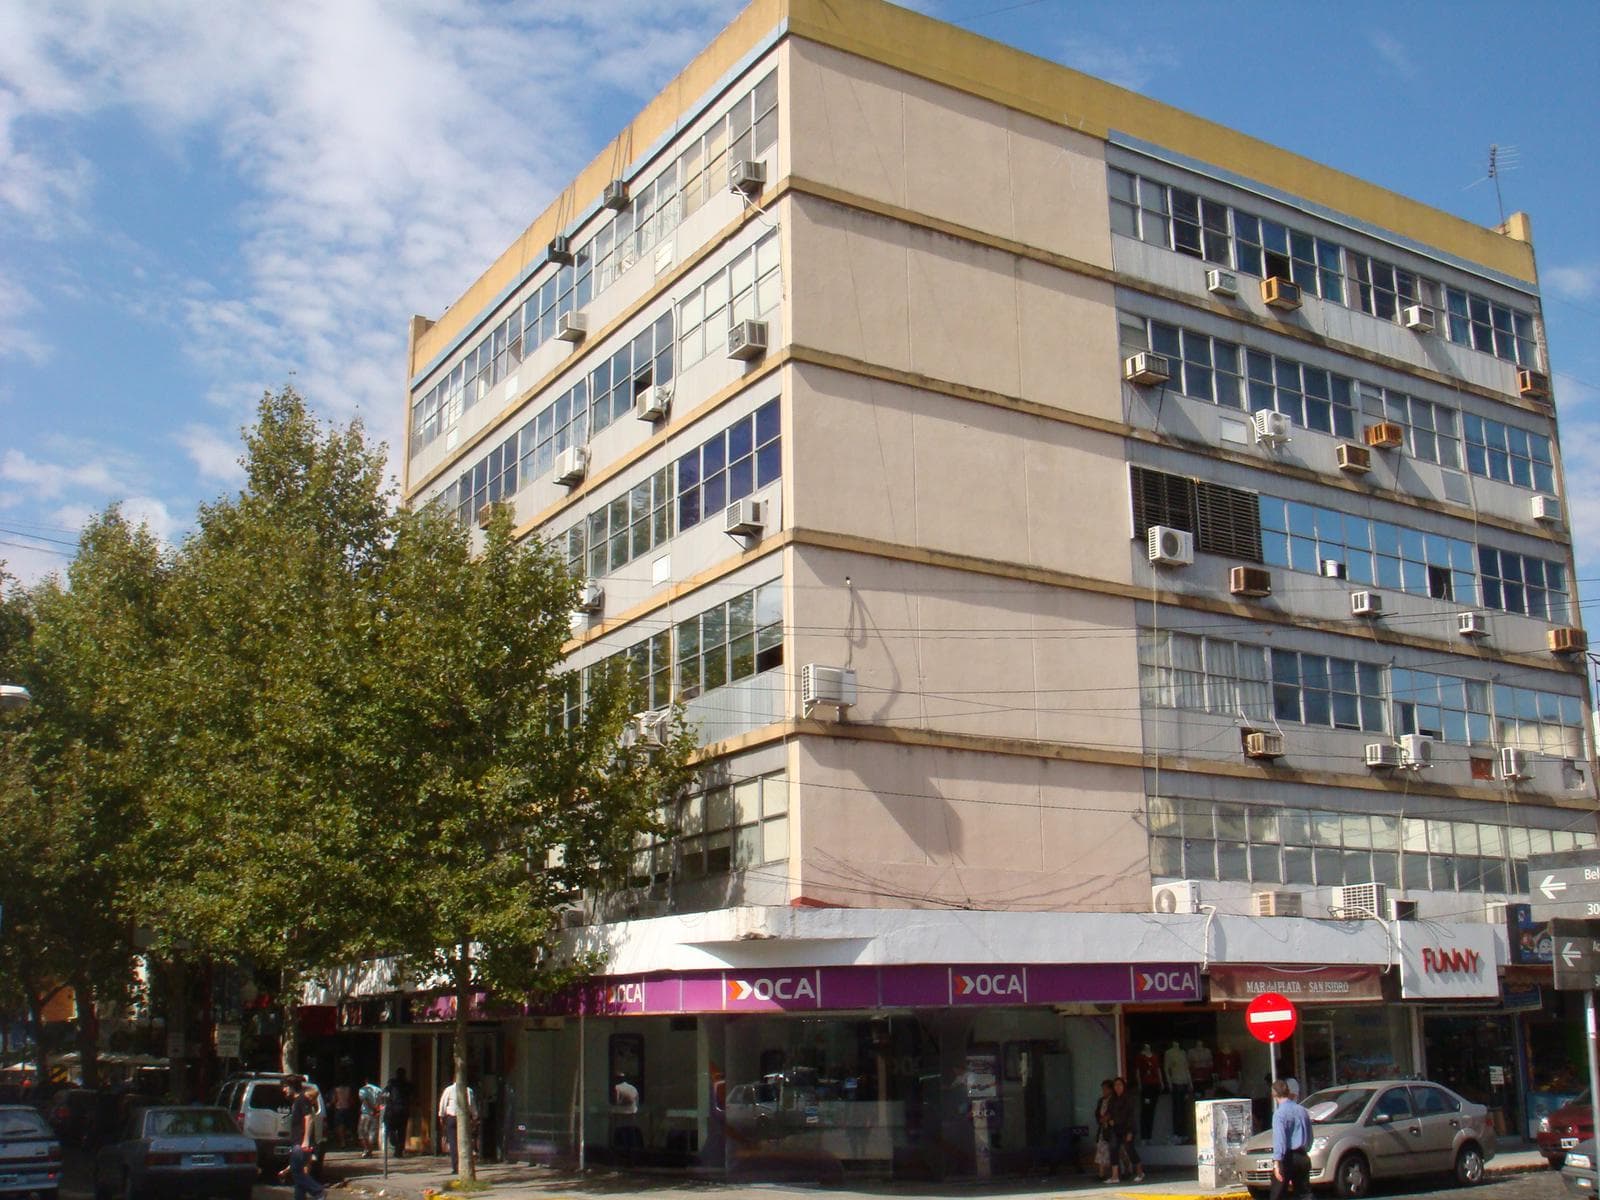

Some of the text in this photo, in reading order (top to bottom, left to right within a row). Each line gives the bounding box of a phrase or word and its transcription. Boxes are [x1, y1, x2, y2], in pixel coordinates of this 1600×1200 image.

[1422, 948, 1479, 973] FUNNY
[753, 978, 816, 1001] OCA
[976, 974, 1023, 995] OCA
[1154, 972, 1195, 991] OCA
[1246, 982, 1265, 993] MAR
[1278, 982, 1301, 993] PLATA
[1309, 982, 1325, 993] SAN
[1325, 982, 1349, 993] ISIDRO
[618, 984, 642, 1003] OCA
